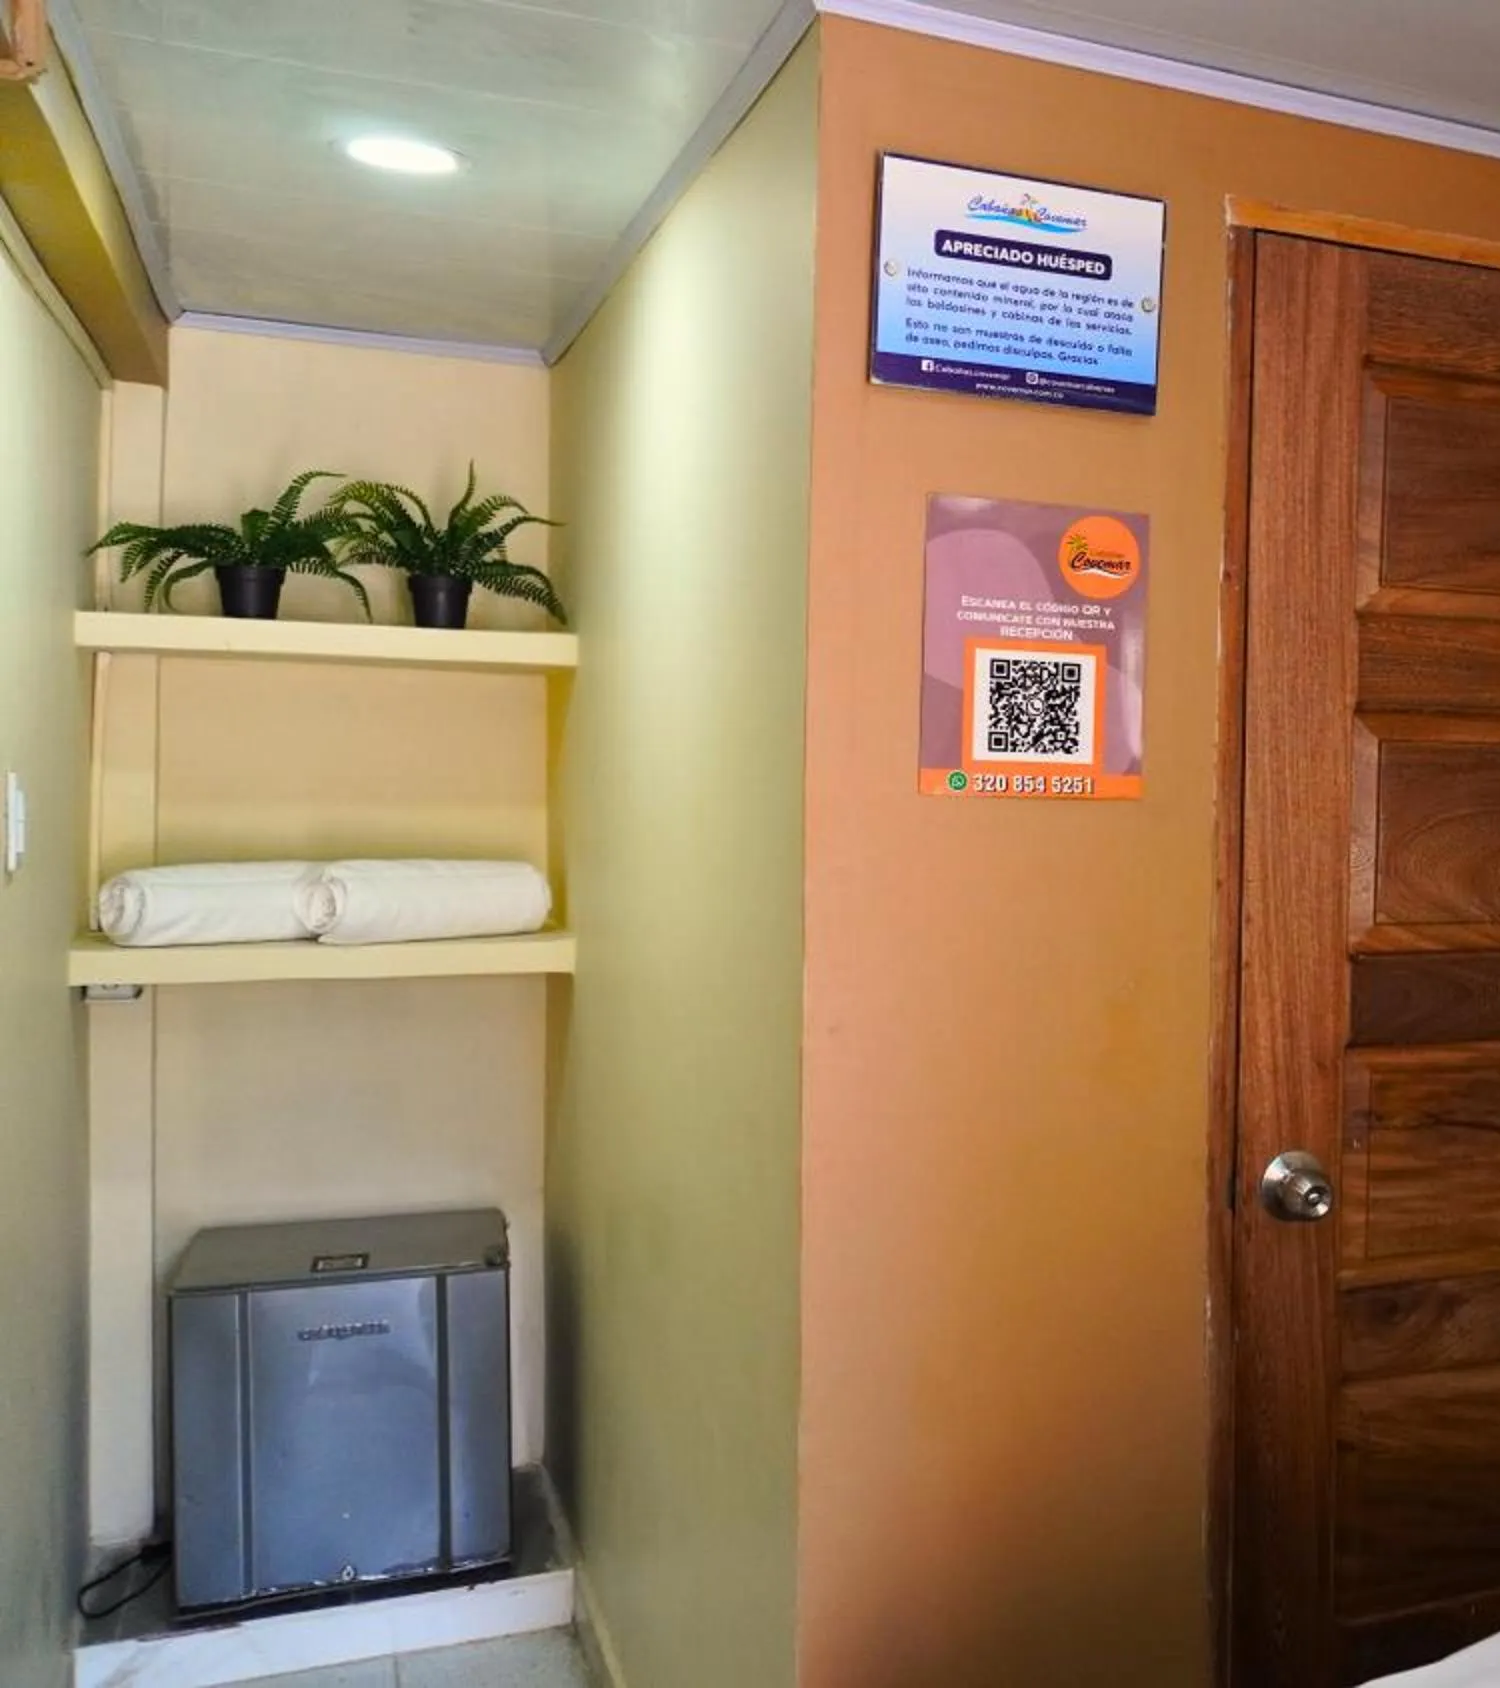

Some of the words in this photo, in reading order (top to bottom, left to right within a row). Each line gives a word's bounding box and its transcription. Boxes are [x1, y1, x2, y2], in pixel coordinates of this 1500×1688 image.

[942, 239, 1034, 264] APRECIADO
[1037, 253, 1105, 275] HUÉSPED
[907, 267, 974, 286] Informamos
[976, 279, 997, 290] que
[1012, 284, 1040, 296] agua
[1042, 288, 1056, 297] de
[1060, 290, 1069, 299] la
[1072, 293, 1105, 305] región
[1108, 298, 1119, 307] es
[1121, 299, 1134, 309] de
[907, 283, 929, 294] alto
[933, 287, 989, 302] contenido
[1040, 302, 1058, 312] por
[927, 299, 986, 316] baldosines
[1002, 310, 1043, 323] cabinas
[1047, 316, 1062, 326] de
[905, 333, 919, 343] de
[953, 341, 1001, 353] pedimos
[933, 323, 948, 332] no
[1028, 334, 1042, 344] de
[1019, 600, 1032, 611] EL
[1082, 604, 1101, 616] QR
[1104, 607, 1112, 616] Y
[1036, 617, 1061, 627] CON
[1063, 620, 1115, 630] NUESTRA
[973, 774, 1008, 793] 320
[1013, 775, 1046, 793] 854
[1052, 776, 1094, 794] 5251
